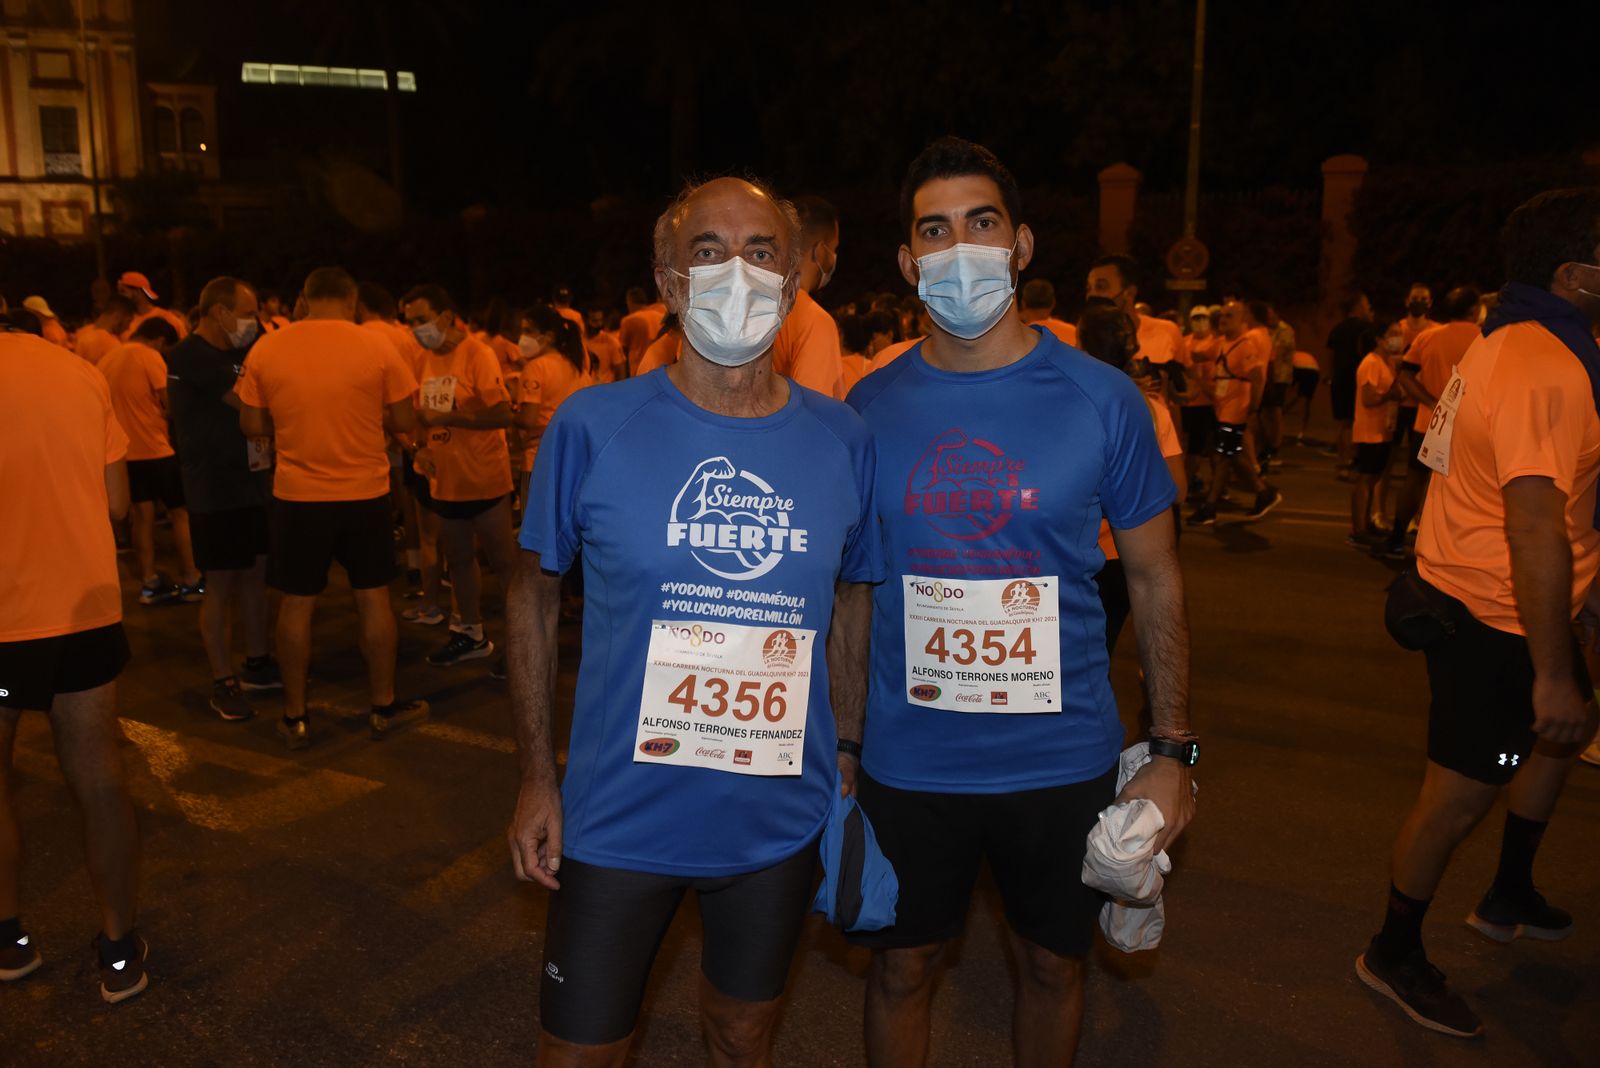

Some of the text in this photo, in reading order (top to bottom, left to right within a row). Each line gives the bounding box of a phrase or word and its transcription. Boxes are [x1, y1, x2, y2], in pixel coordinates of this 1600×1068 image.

[940, 454, 1025, 481] Siempre
[706, 484, 795, 516] Siempre
[903, 488, 1041, 517] FUERTE
[667, 522, 808, 553] FUERTE
[661, 582, 806, 609] #YODONO #DONAMÉDULA
[662, 599, 804, 625] #YOLUCHOPORELMILLÓN
[989, 617, 1032, 626] GUADALQUIVIR
[924, 626, 1037, 667] 4354
[672, 662, 700, 671] CARRERA
[700, 665, 735, 675] NOCTURNA
[747, 670, 786, 678] GUADALQUIVIR
[912, 665, 1055, 682] ALFONSO TERRONES MORENO
[667, 673, 788, 723] 4356
[642, 716, 803, 740] ALFONSO TERRONES FERNANDEZ
